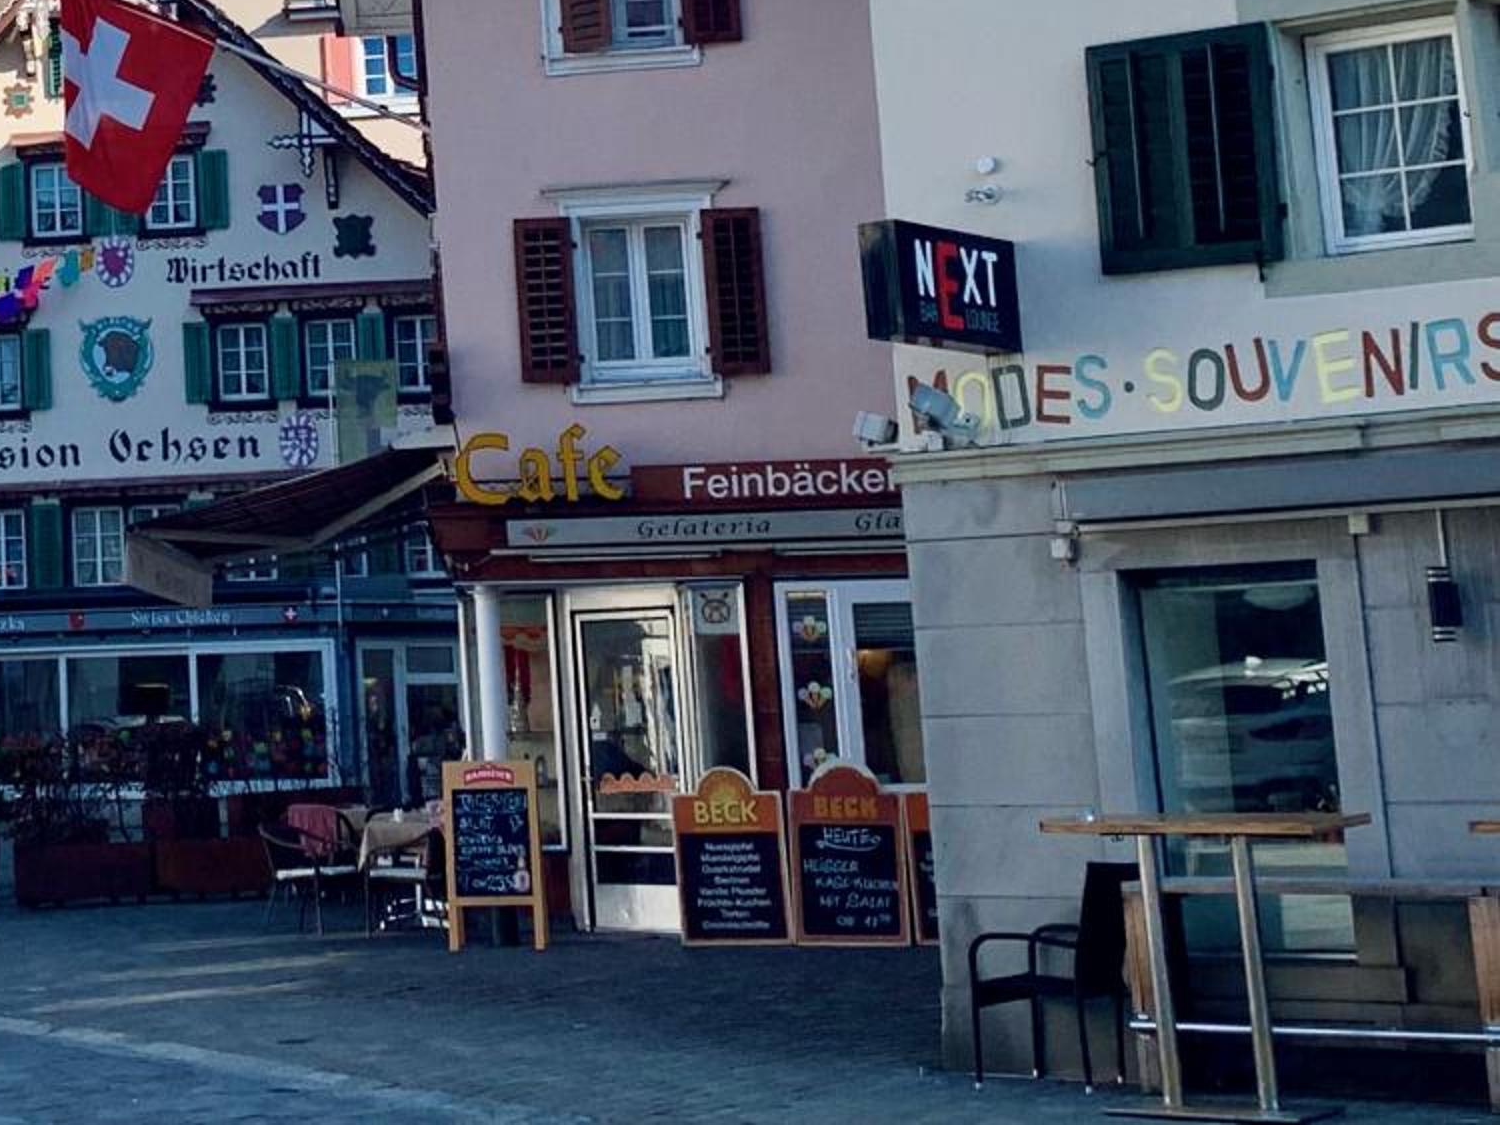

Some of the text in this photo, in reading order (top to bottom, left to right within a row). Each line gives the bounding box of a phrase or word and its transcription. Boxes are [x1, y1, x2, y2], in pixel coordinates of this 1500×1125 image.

[166, 251, 320, 284] Wirtschaft
[914, 238, 999, 331] NEXT
[108, 427, 261, 465] Ochsen
[637, 517, 772, 539] Gelateria
[693, 800, 758, 824] BECK
[813, 795, 878, 819] BECK
